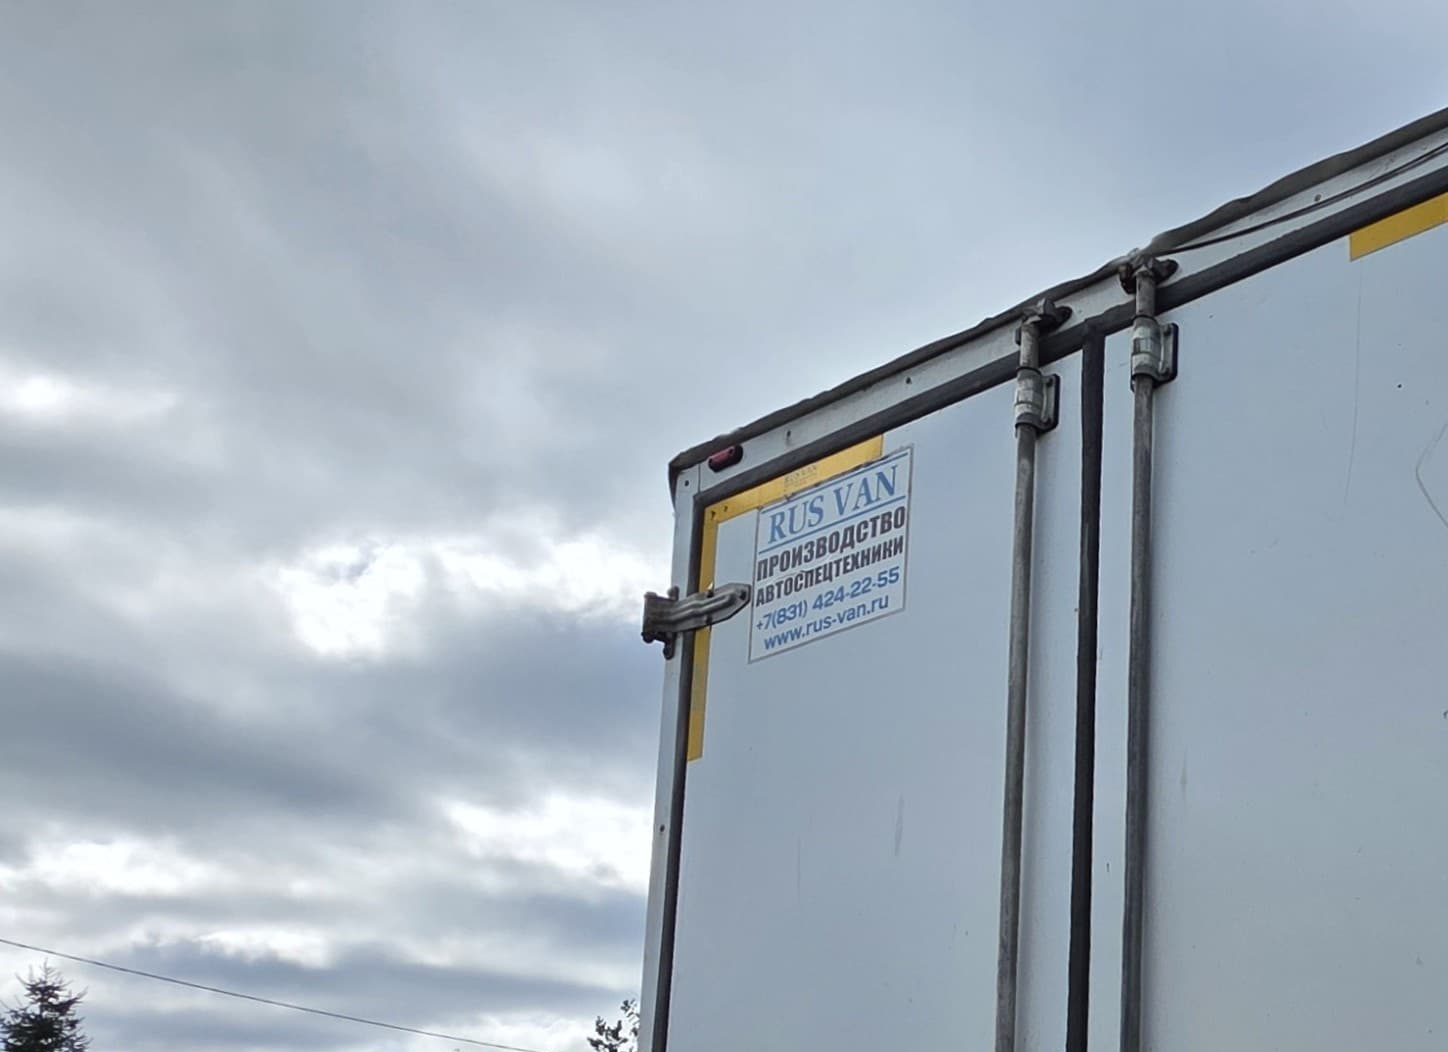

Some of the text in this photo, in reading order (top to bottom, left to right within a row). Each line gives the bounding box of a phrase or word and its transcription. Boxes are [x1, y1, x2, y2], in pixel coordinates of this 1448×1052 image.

[768, 495, 824, 544] RUS
[833, 465, 898, 516] VAN
[756, 536, 904, 607] АВТОСПЕЦТЕХНИКИ
[757, 505, 906, 582] ПРОИЗВОДСТВО
[756, 566, 900, 630] +7(831) 424-22-55
[764, 595, 889, 650] www.rus-van.ru
